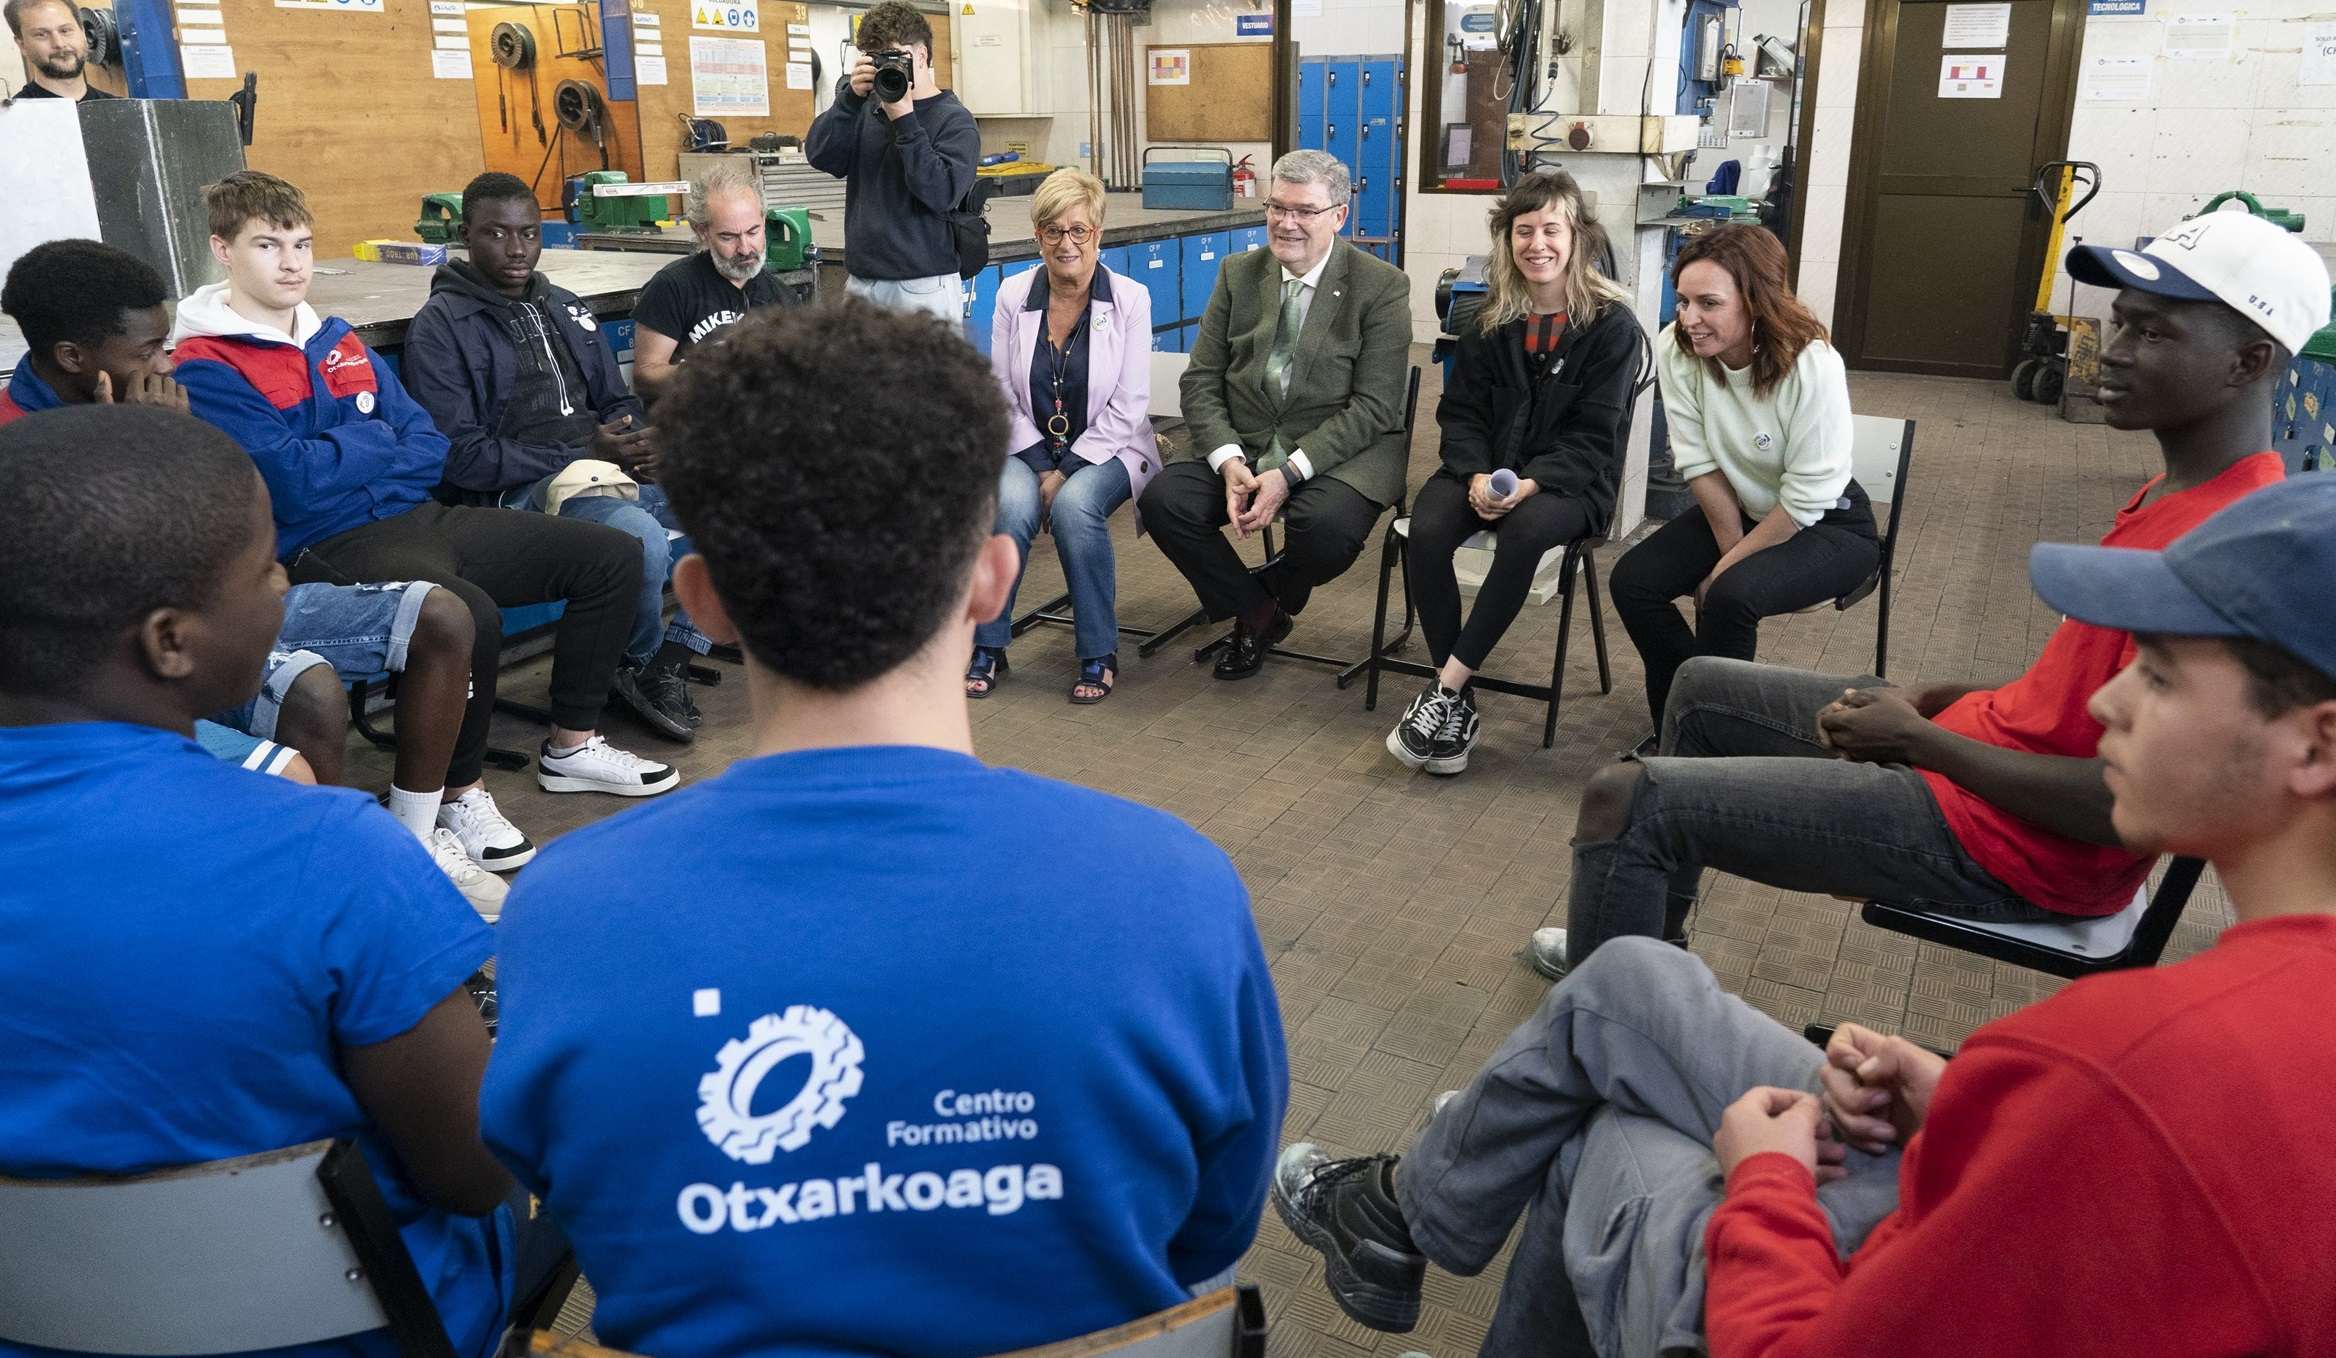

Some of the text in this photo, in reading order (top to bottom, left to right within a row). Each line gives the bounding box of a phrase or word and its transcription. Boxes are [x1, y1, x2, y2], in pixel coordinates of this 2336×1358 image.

[617, 325, 631, 337] CF
[933, 1088, 1035, 1118] Centro
[886, 1115, 1038, 1147] Formativo
[676, 1162, 1064, 1235] Otxarkoaga
